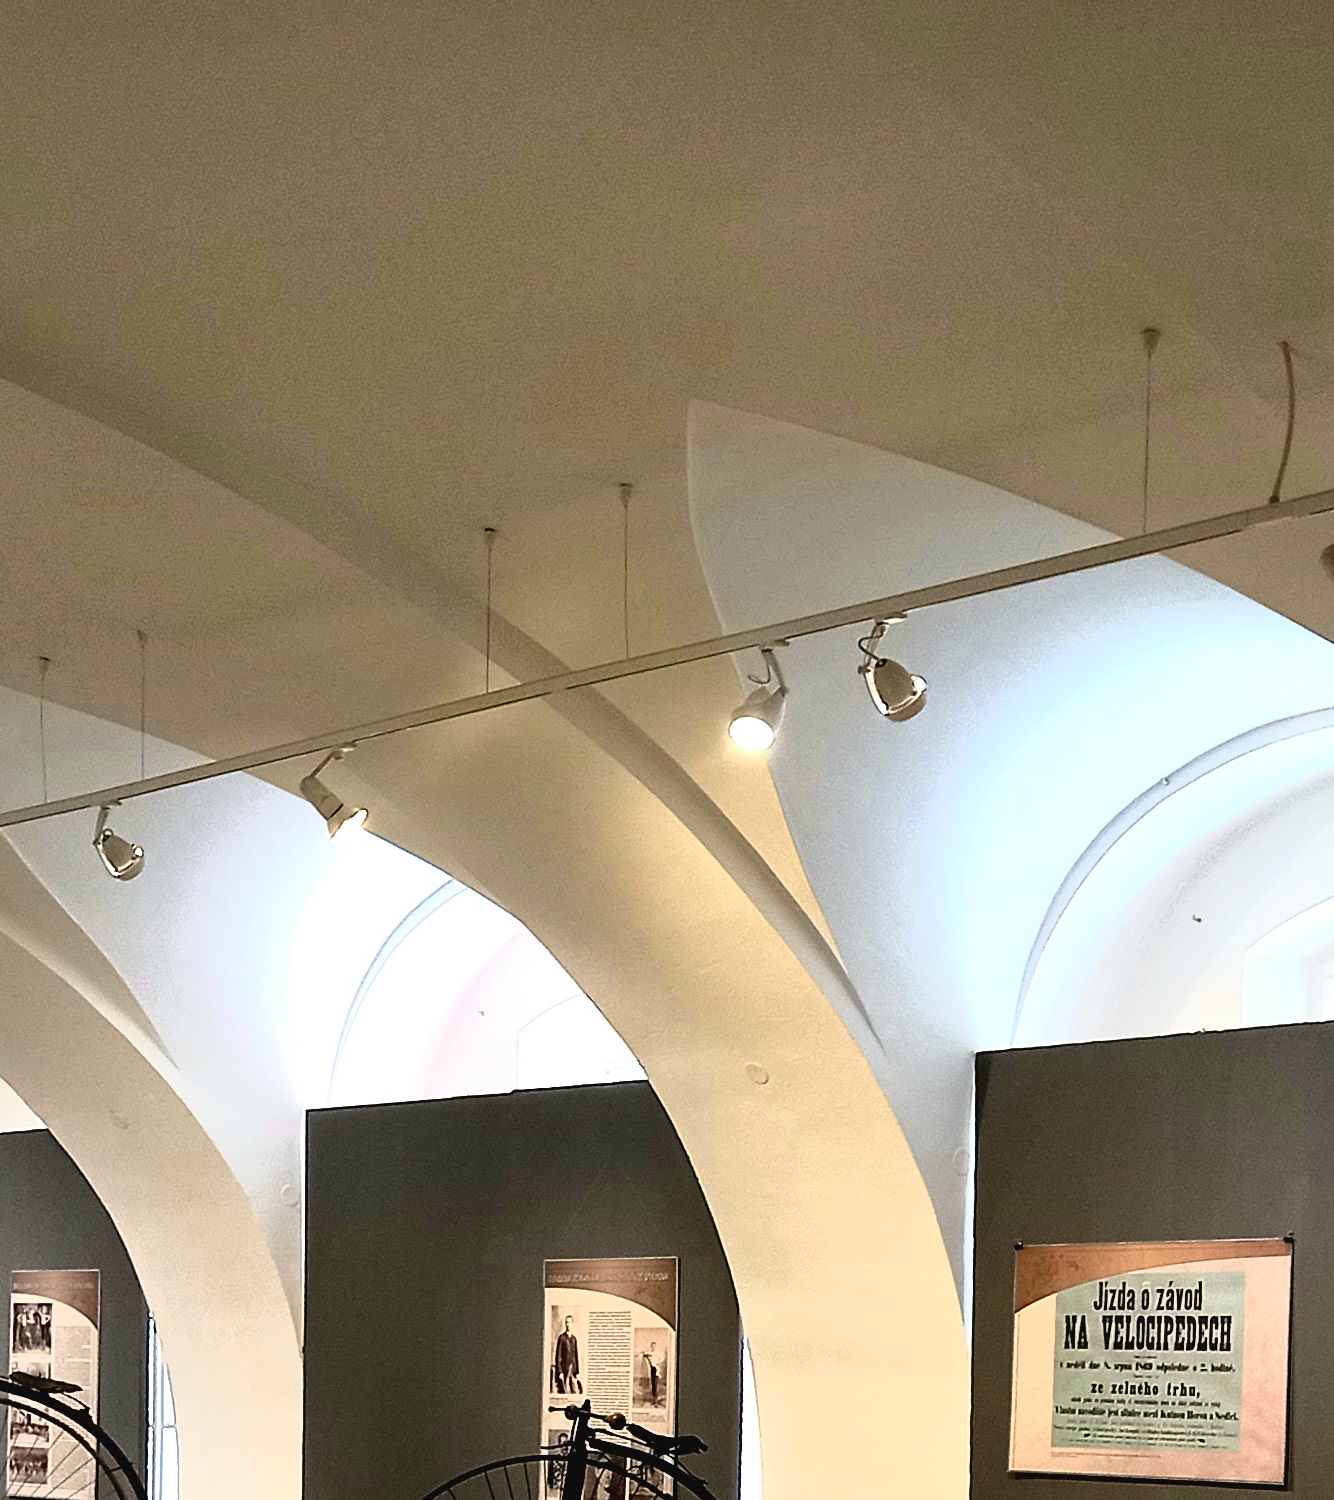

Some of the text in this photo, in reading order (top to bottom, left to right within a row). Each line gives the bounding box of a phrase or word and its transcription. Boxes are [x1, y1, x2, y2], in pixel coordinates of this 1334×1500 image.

[1093, 1280, 1203, 1311] Jízda o závod
[1064, 1314, 1233, 1352] NA VELOCIPEDECH
[1090, 1383, 1104, 1394] ze
[1110, 1380, 1159, 1396] zelného
